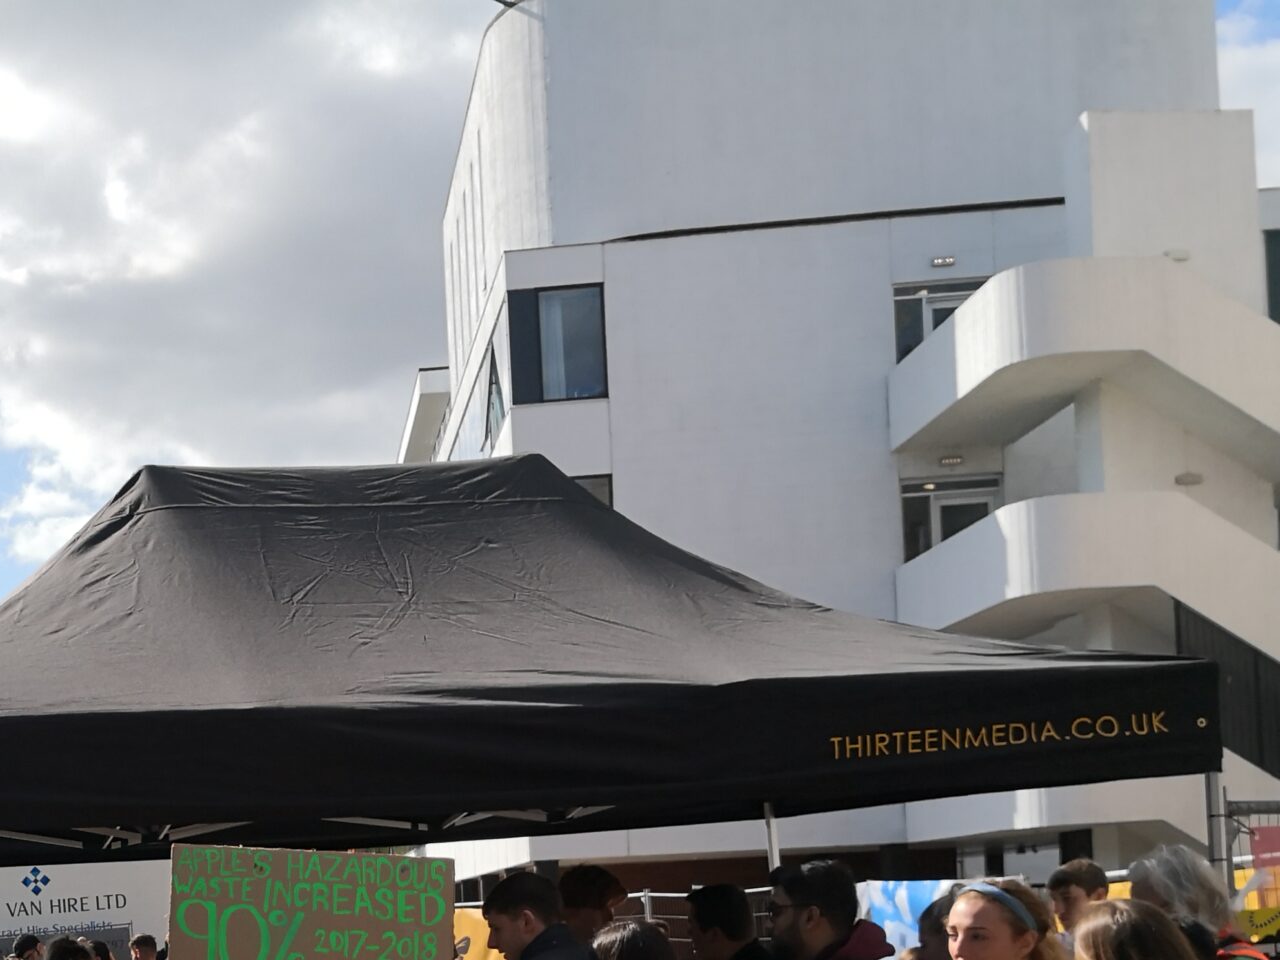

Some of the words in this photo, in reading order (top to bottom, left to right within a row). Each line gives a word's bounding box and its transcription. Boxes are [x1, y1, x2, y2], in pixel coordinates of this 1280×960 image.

[830, 711, 1169, 760] THIRTEENMEDIA.CO.UK
[177, 847, 273, 879] APPLE'S
[286, 853, 448, 893] HAZARDOUS
[6, 901, 43, 918] VAN
[50, 897, 90, 914] HIRE
[96, 893, 127, 911] LTD
[172, 876, 256, 901] WASTE
[263, 877, 447, 926] INCREASED
[27, 924, 50, 935] Hire
